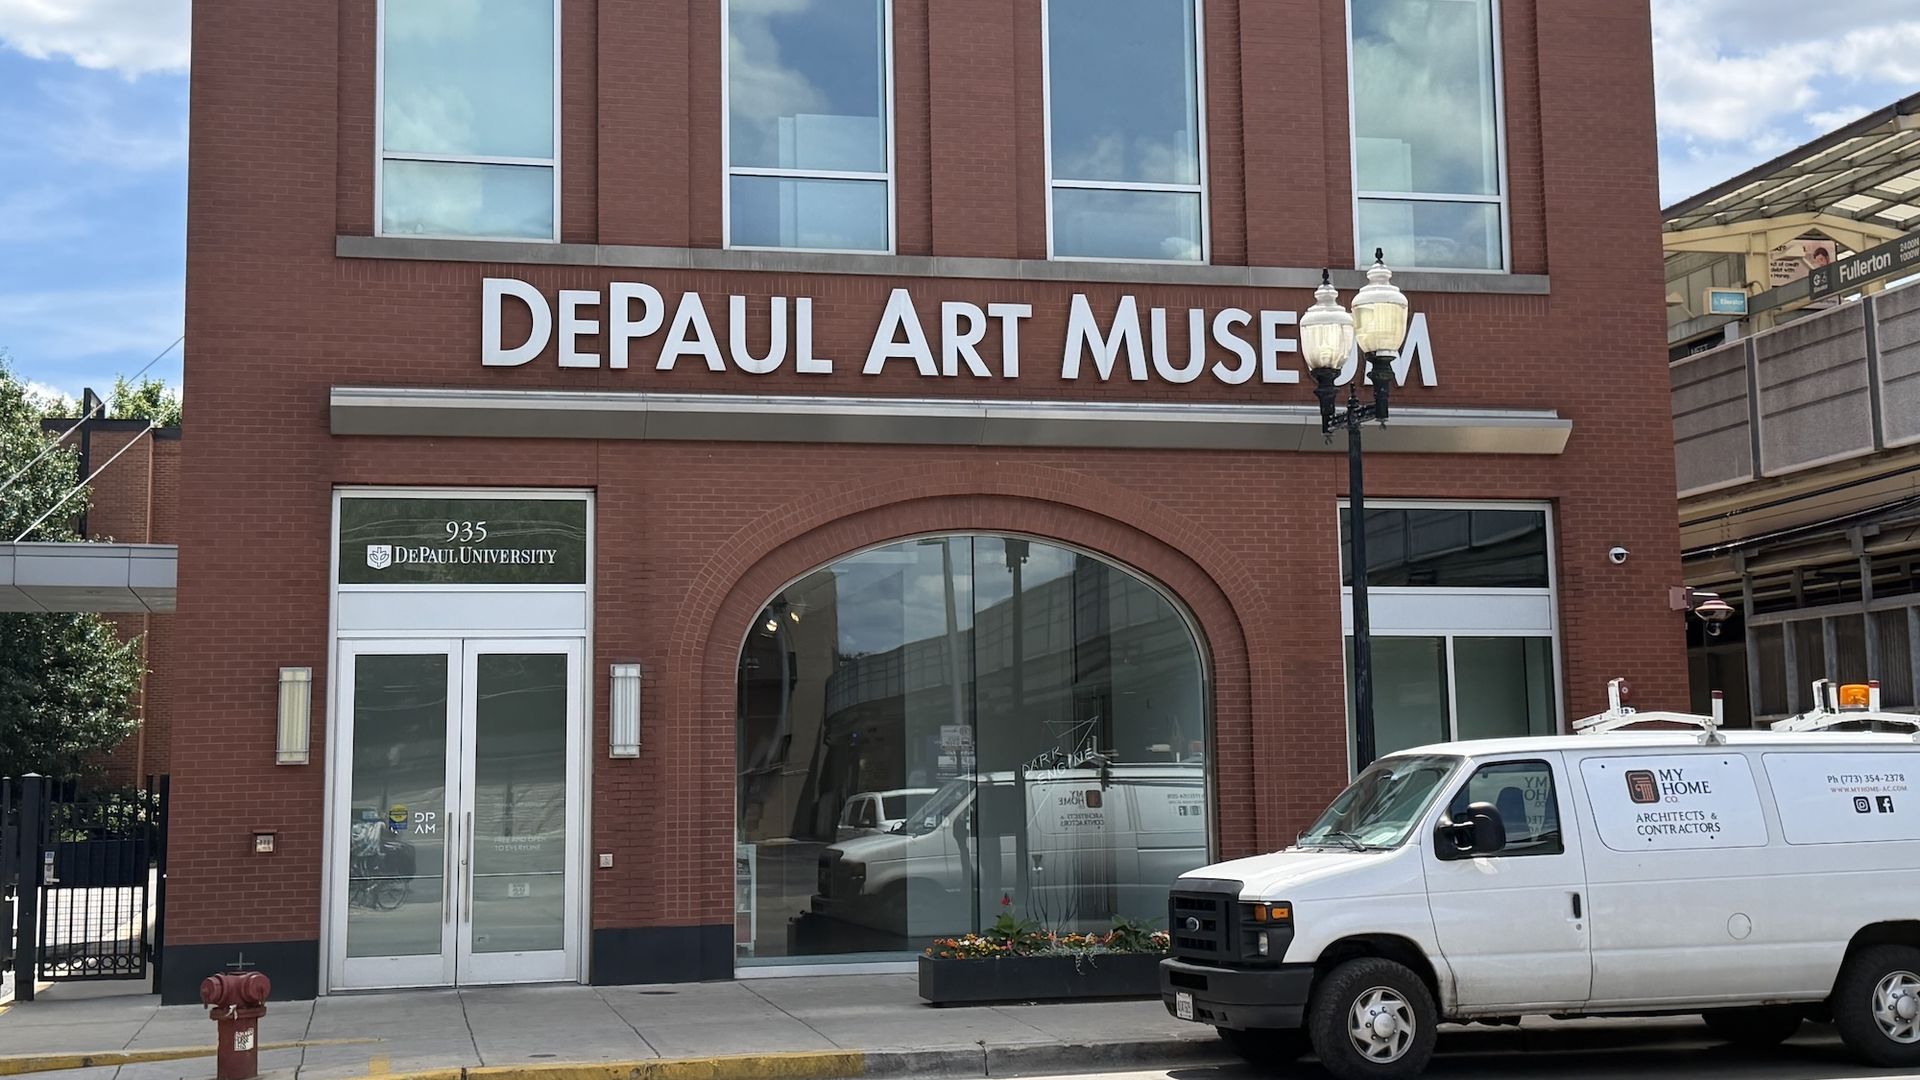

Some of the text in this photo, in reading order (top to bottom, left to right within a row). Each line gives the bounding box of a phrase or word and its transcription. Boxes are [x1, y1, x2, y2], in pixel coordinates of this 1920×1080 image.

[1839, 253, 1892, 283] Fullerton
[482, 278, 1438, 387] DEPAUL ART MUSEM
[445, 520, 488, 543] 935
[393, 546, 557, 565] DEPAUL UNIVERSITY
[1021, 746, 1063, 777] DARK
[1037, 747, 1095, 784] ENGINE
[1658, 768, 1683, 782] MY
[1826, 773, 1905, 785] Ph (773) 354-2378
[1661, 781, 1712, 795] HOME
[414, 812, 436, 823] DP
[1636, 811, 1718, 823] ARCHITECTS &
[1637, 822, 1721, 836] CONTRACTORS
